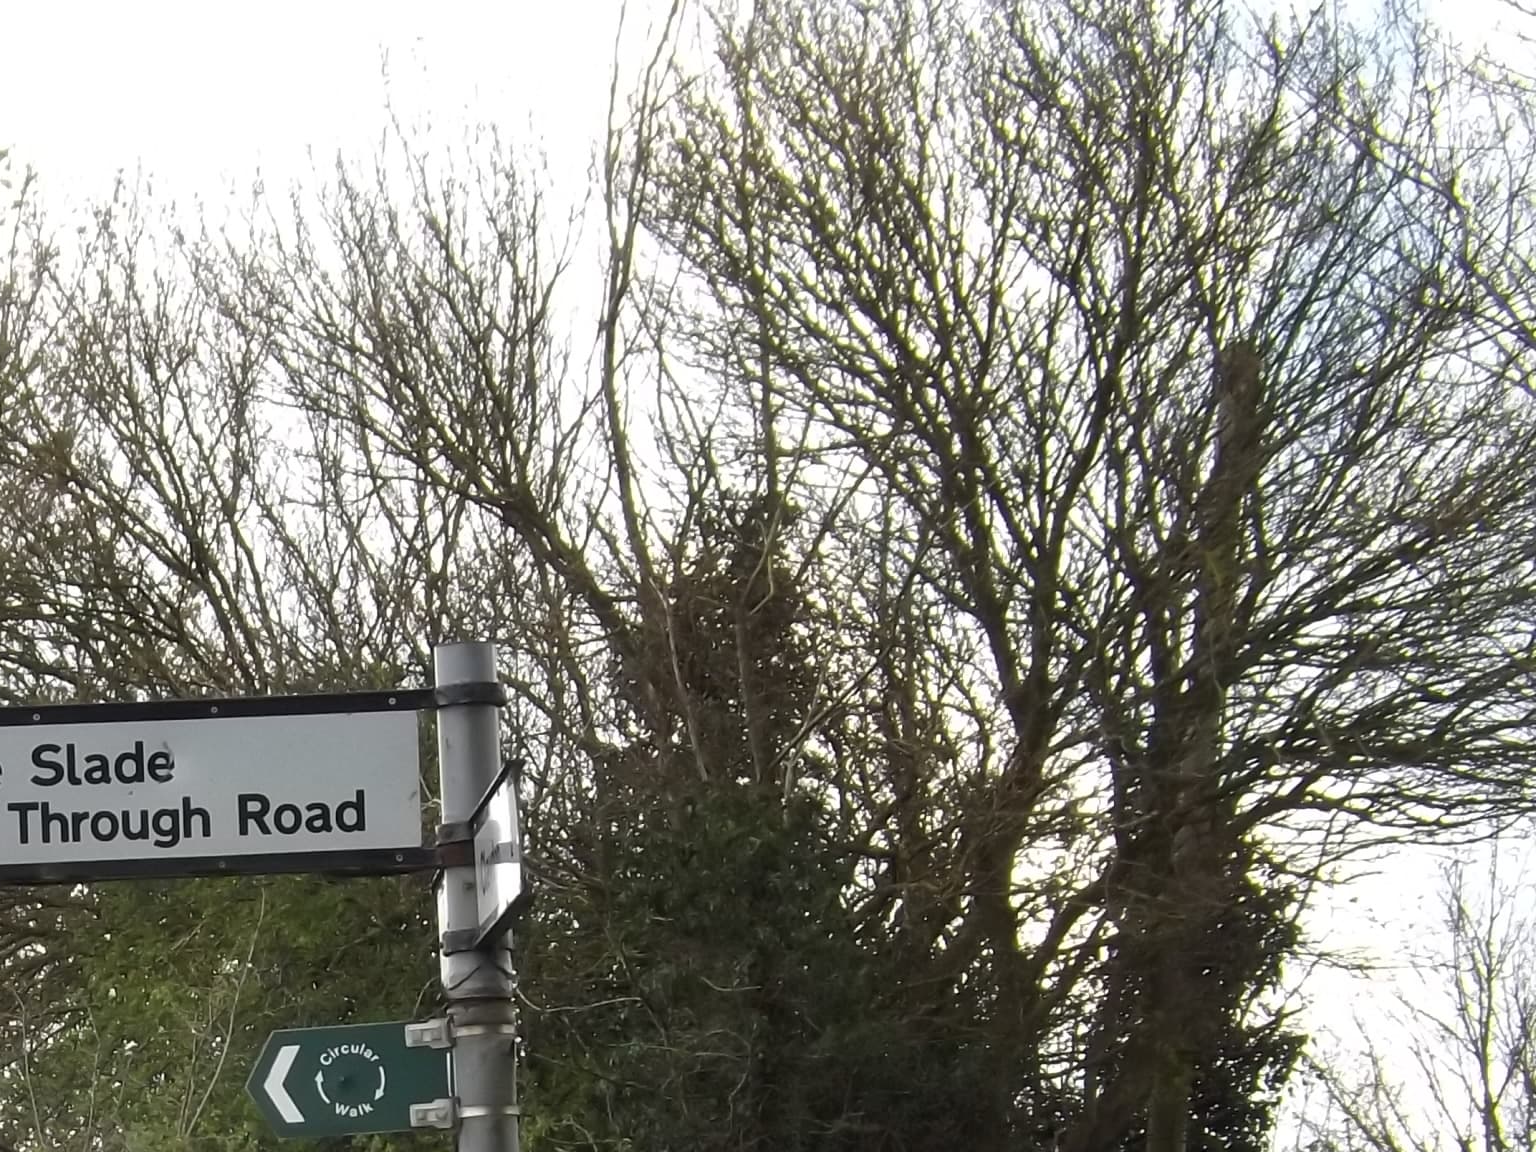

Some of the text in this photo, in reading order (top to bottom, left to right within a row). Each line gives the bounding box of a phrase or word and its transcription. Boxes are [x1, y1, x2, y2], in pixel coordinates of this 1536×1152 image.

[30, 740, 175, 786] Slade
[7, 796, 211, 849] Through
[238, 789, 366, 837] Road
[320, 1043, 380, 1067] Circular
[334, 1102, 374, 1117] Walk
